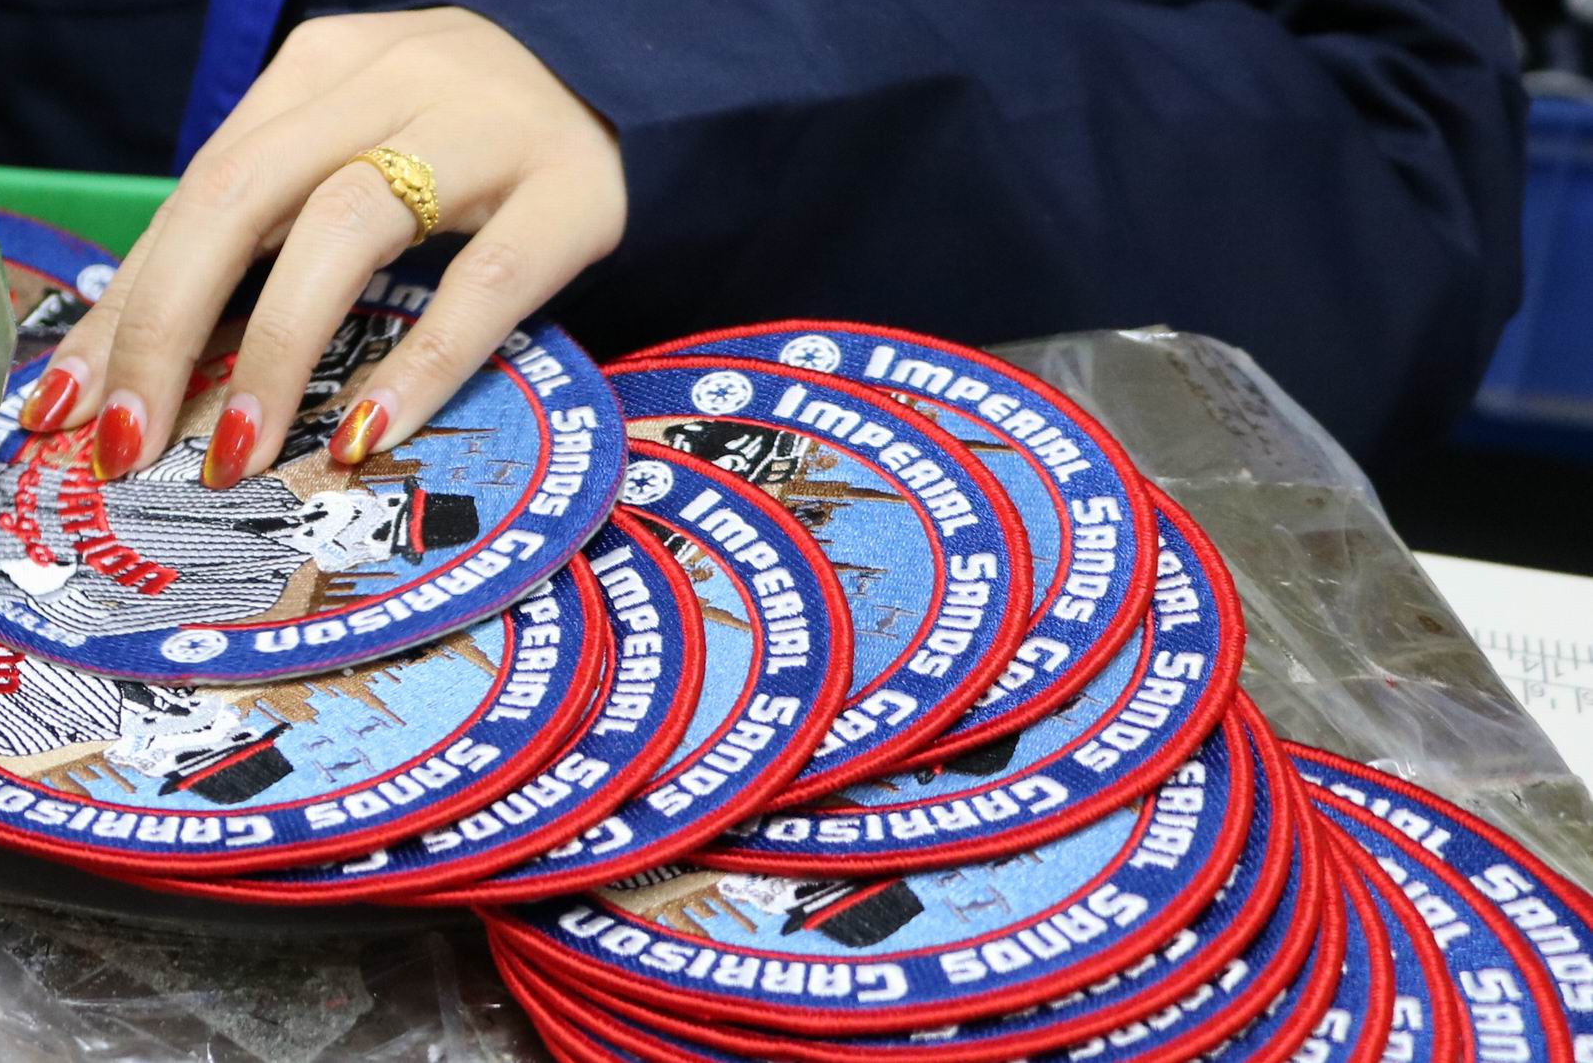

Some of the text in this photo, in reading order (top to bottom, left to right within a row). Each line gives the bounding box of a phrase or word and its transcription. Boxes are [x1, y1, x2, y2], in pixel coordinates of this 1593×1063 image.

[528, 405, 598, 519] SANDS
[863, 345, 1093, 487] IMPERIAL
[1049, 494, 1123, 625] SANDS
[773, 383, 979, 538] IMPERIAL
[916, 552, 997, 680] SANDS
[253, 528, 545, 656] GARRISON
[485, 580, 561, 722] PERIAL
[590, 545, 663, 736] IMPERIAL
[647, 489, 811, 817] IMPERIAL SANDS
[1075, 651, 1204, 773] SANDS
[305, 737, 503, 832] SANDS
[420, 751, 610, 853] SANDS
[762, 774, 1070, 843] GARRISO
[557, 905, 909, 1004] GARRISON
[938, 882, 1149, 985] SANDS
[1459, 967, 1530, 1063] SAN
